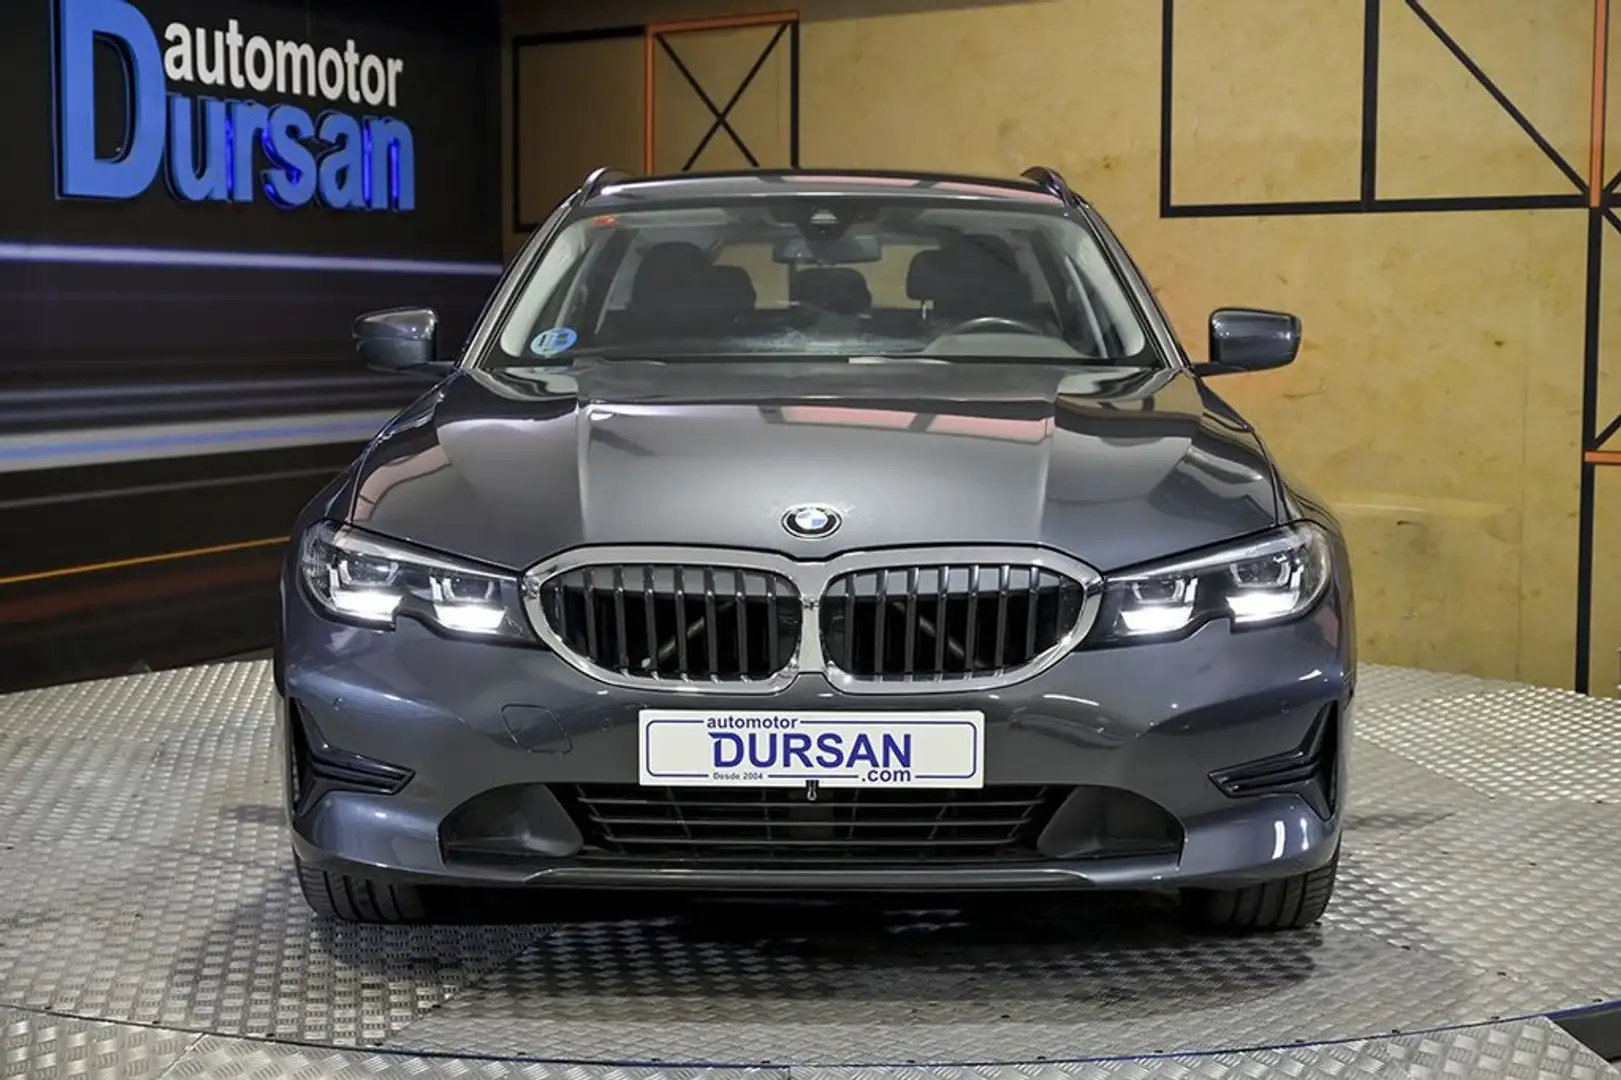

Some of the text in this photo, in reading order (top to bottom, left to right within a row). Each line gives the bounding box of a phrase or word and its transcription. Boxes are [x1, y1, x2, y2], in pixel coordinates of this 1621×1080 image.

[164, 18, 403, 106] automotor
[54, 0, 415, 209] Dursan
[706, 715, 797, 729] automotor
[709, 732, 911, 768] DURSAN
[713, 771, 764, 781] Desde 2004
[861, 768, 911, 782] .com
